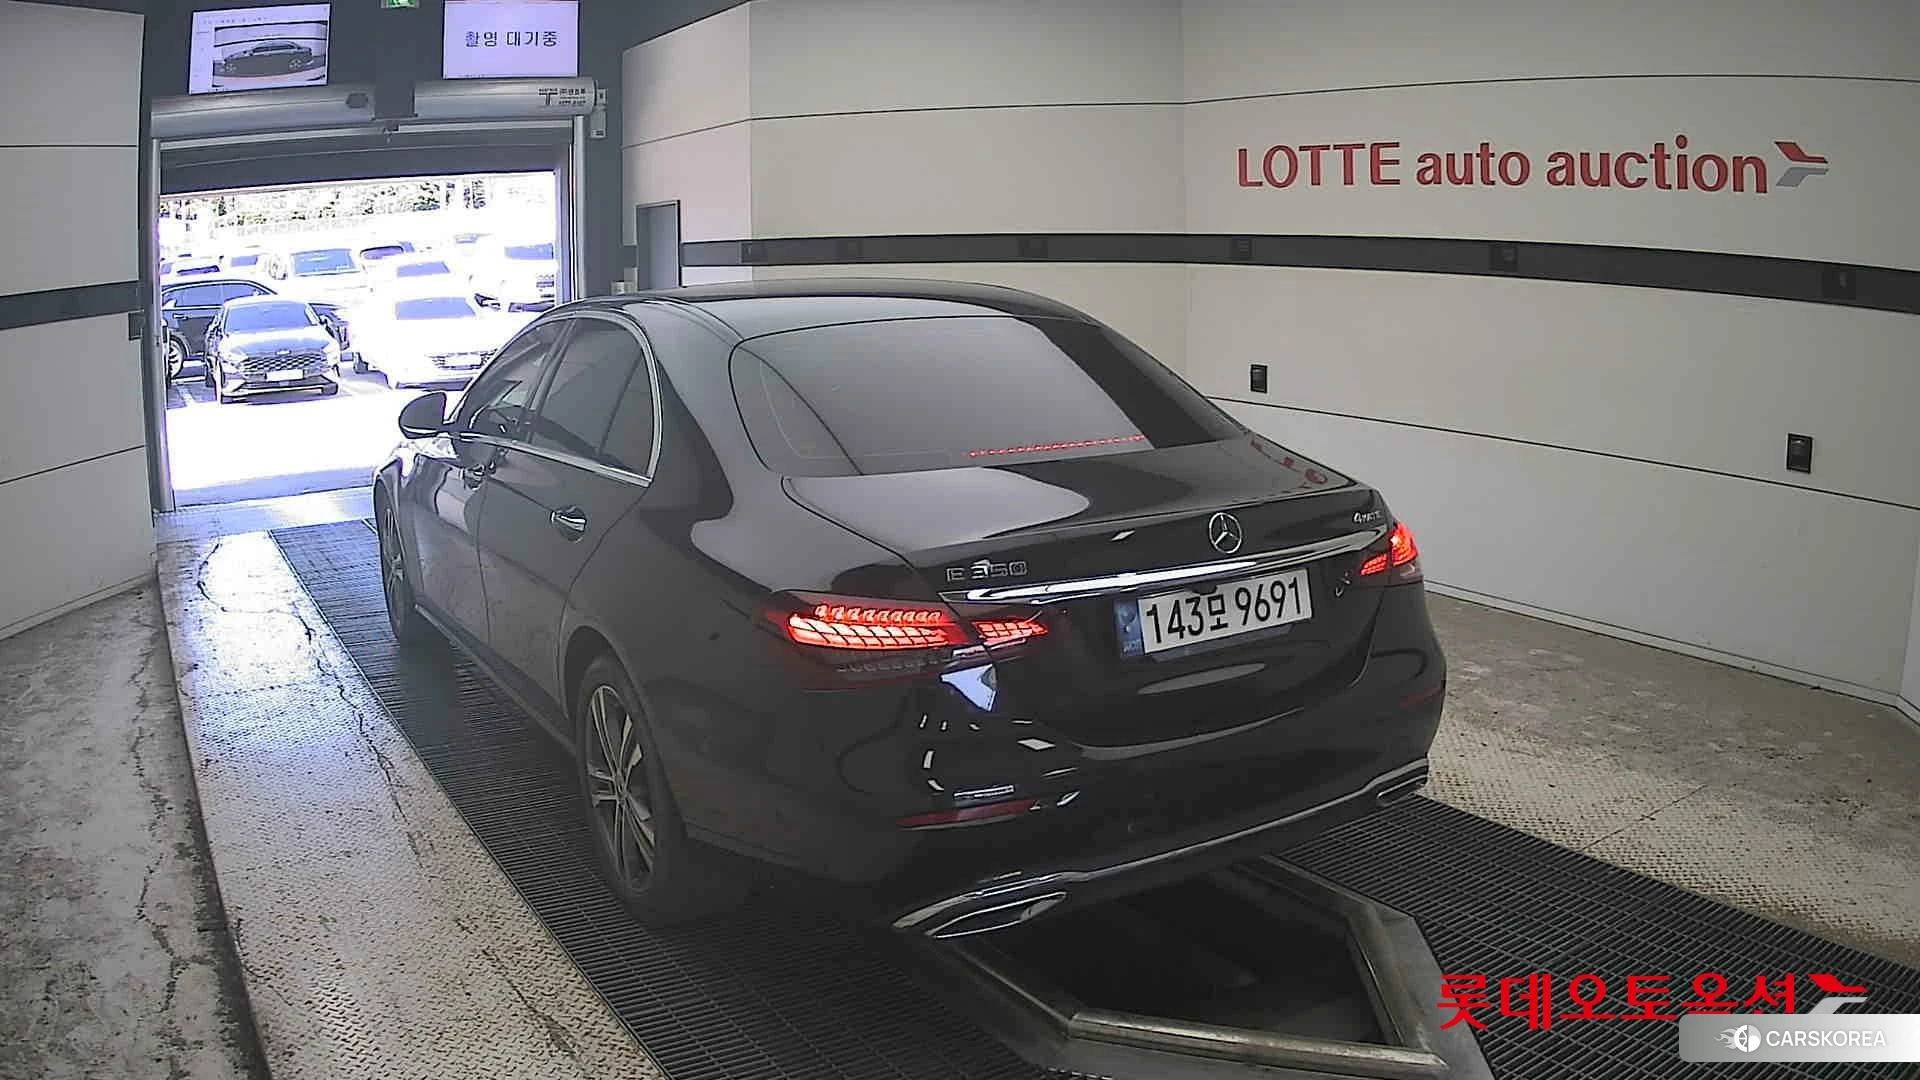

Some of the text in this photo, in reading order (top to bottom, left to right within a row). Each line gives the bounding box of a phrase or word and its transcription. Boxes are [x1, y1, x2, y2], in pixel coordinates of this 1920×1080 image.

[465, 31, 558, 48] 촬영 대기중
[1236, 135, 1768, 193] LOTTE auto auction
[946, 559, 1028, 581] E 350
[1147, 576, 1302, 644] 143모 9691
